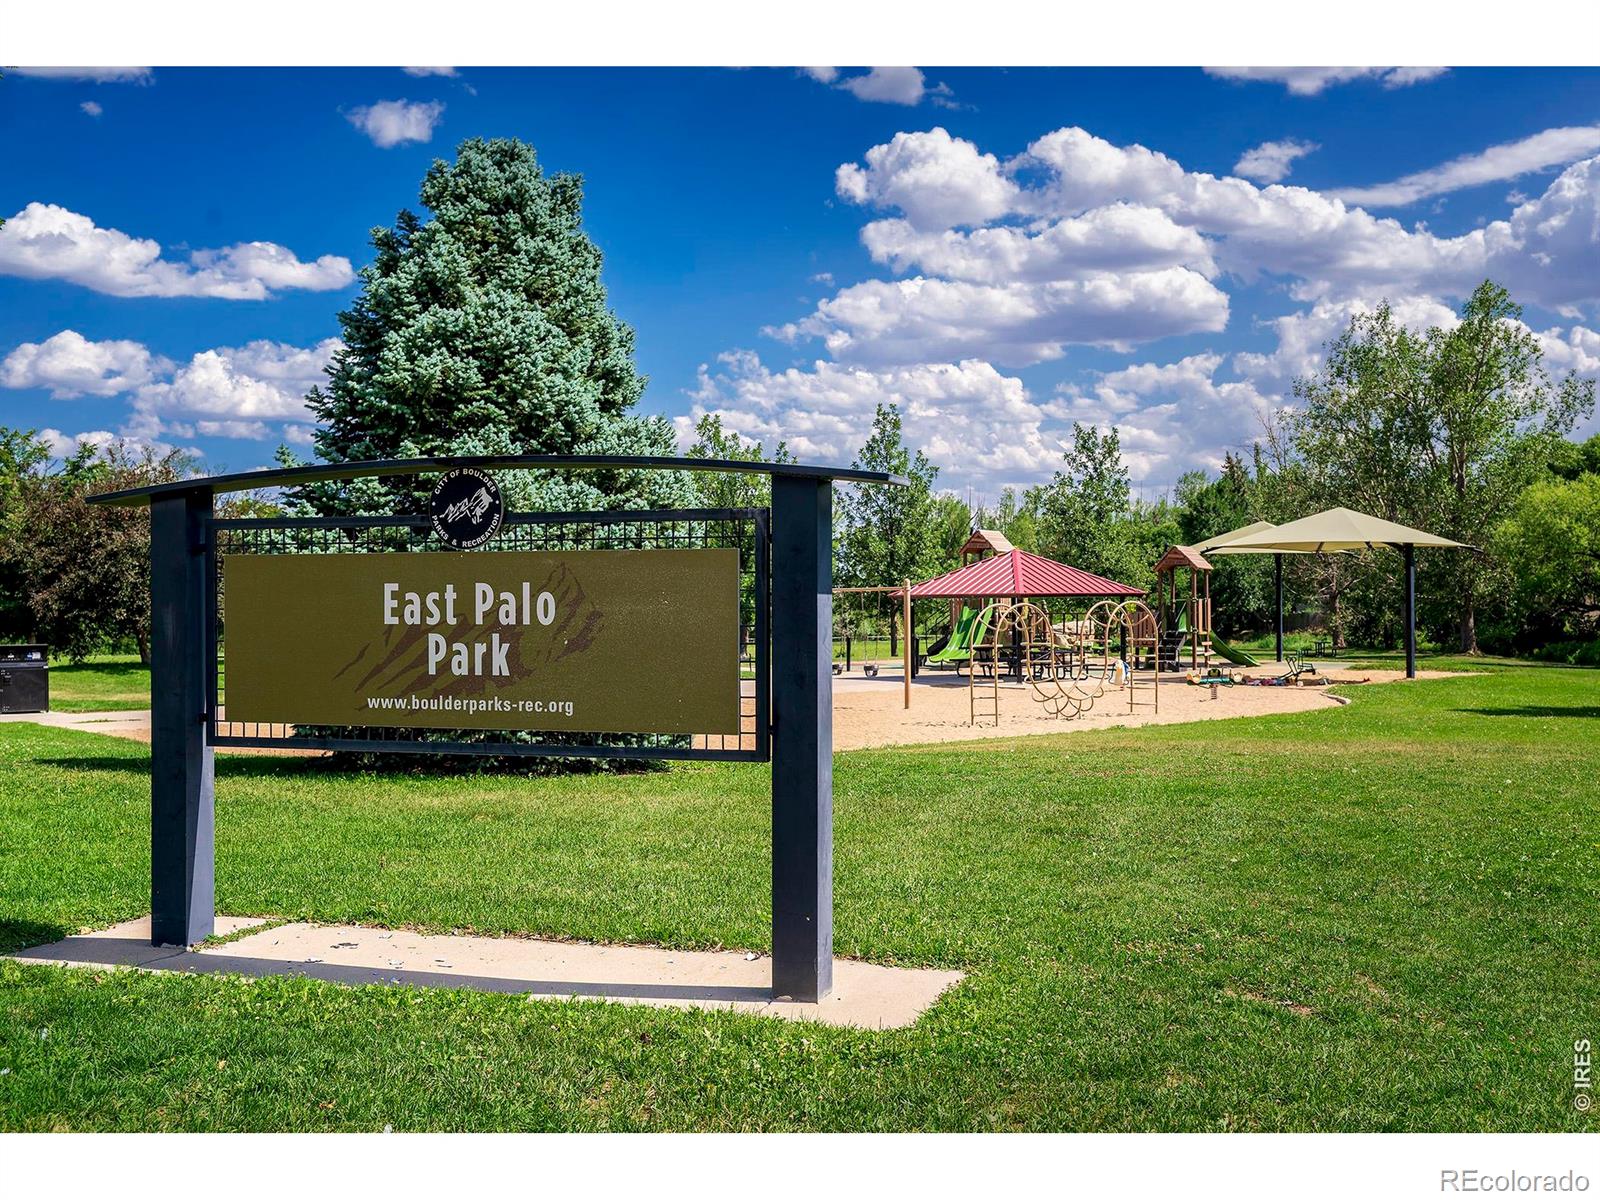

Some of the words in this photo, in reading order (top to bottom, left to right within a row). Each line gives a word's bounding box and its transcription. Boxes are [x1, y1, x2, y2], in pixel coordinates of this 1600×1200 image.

[434, 476, 448, 495] CITY
[450, 469, 460, 478] OF
[463, 468, 497, 493] BOULDER
[432, 514, 449, 540] PARKS
[462, 513, 500, 547] RECREATION
[384, 582, 458, 626] East
[475, 581, 556, 626] Palo
[428, 633, 511, 676] Park
[367, 695, 574, 717] www.boulderparks-rec.org
